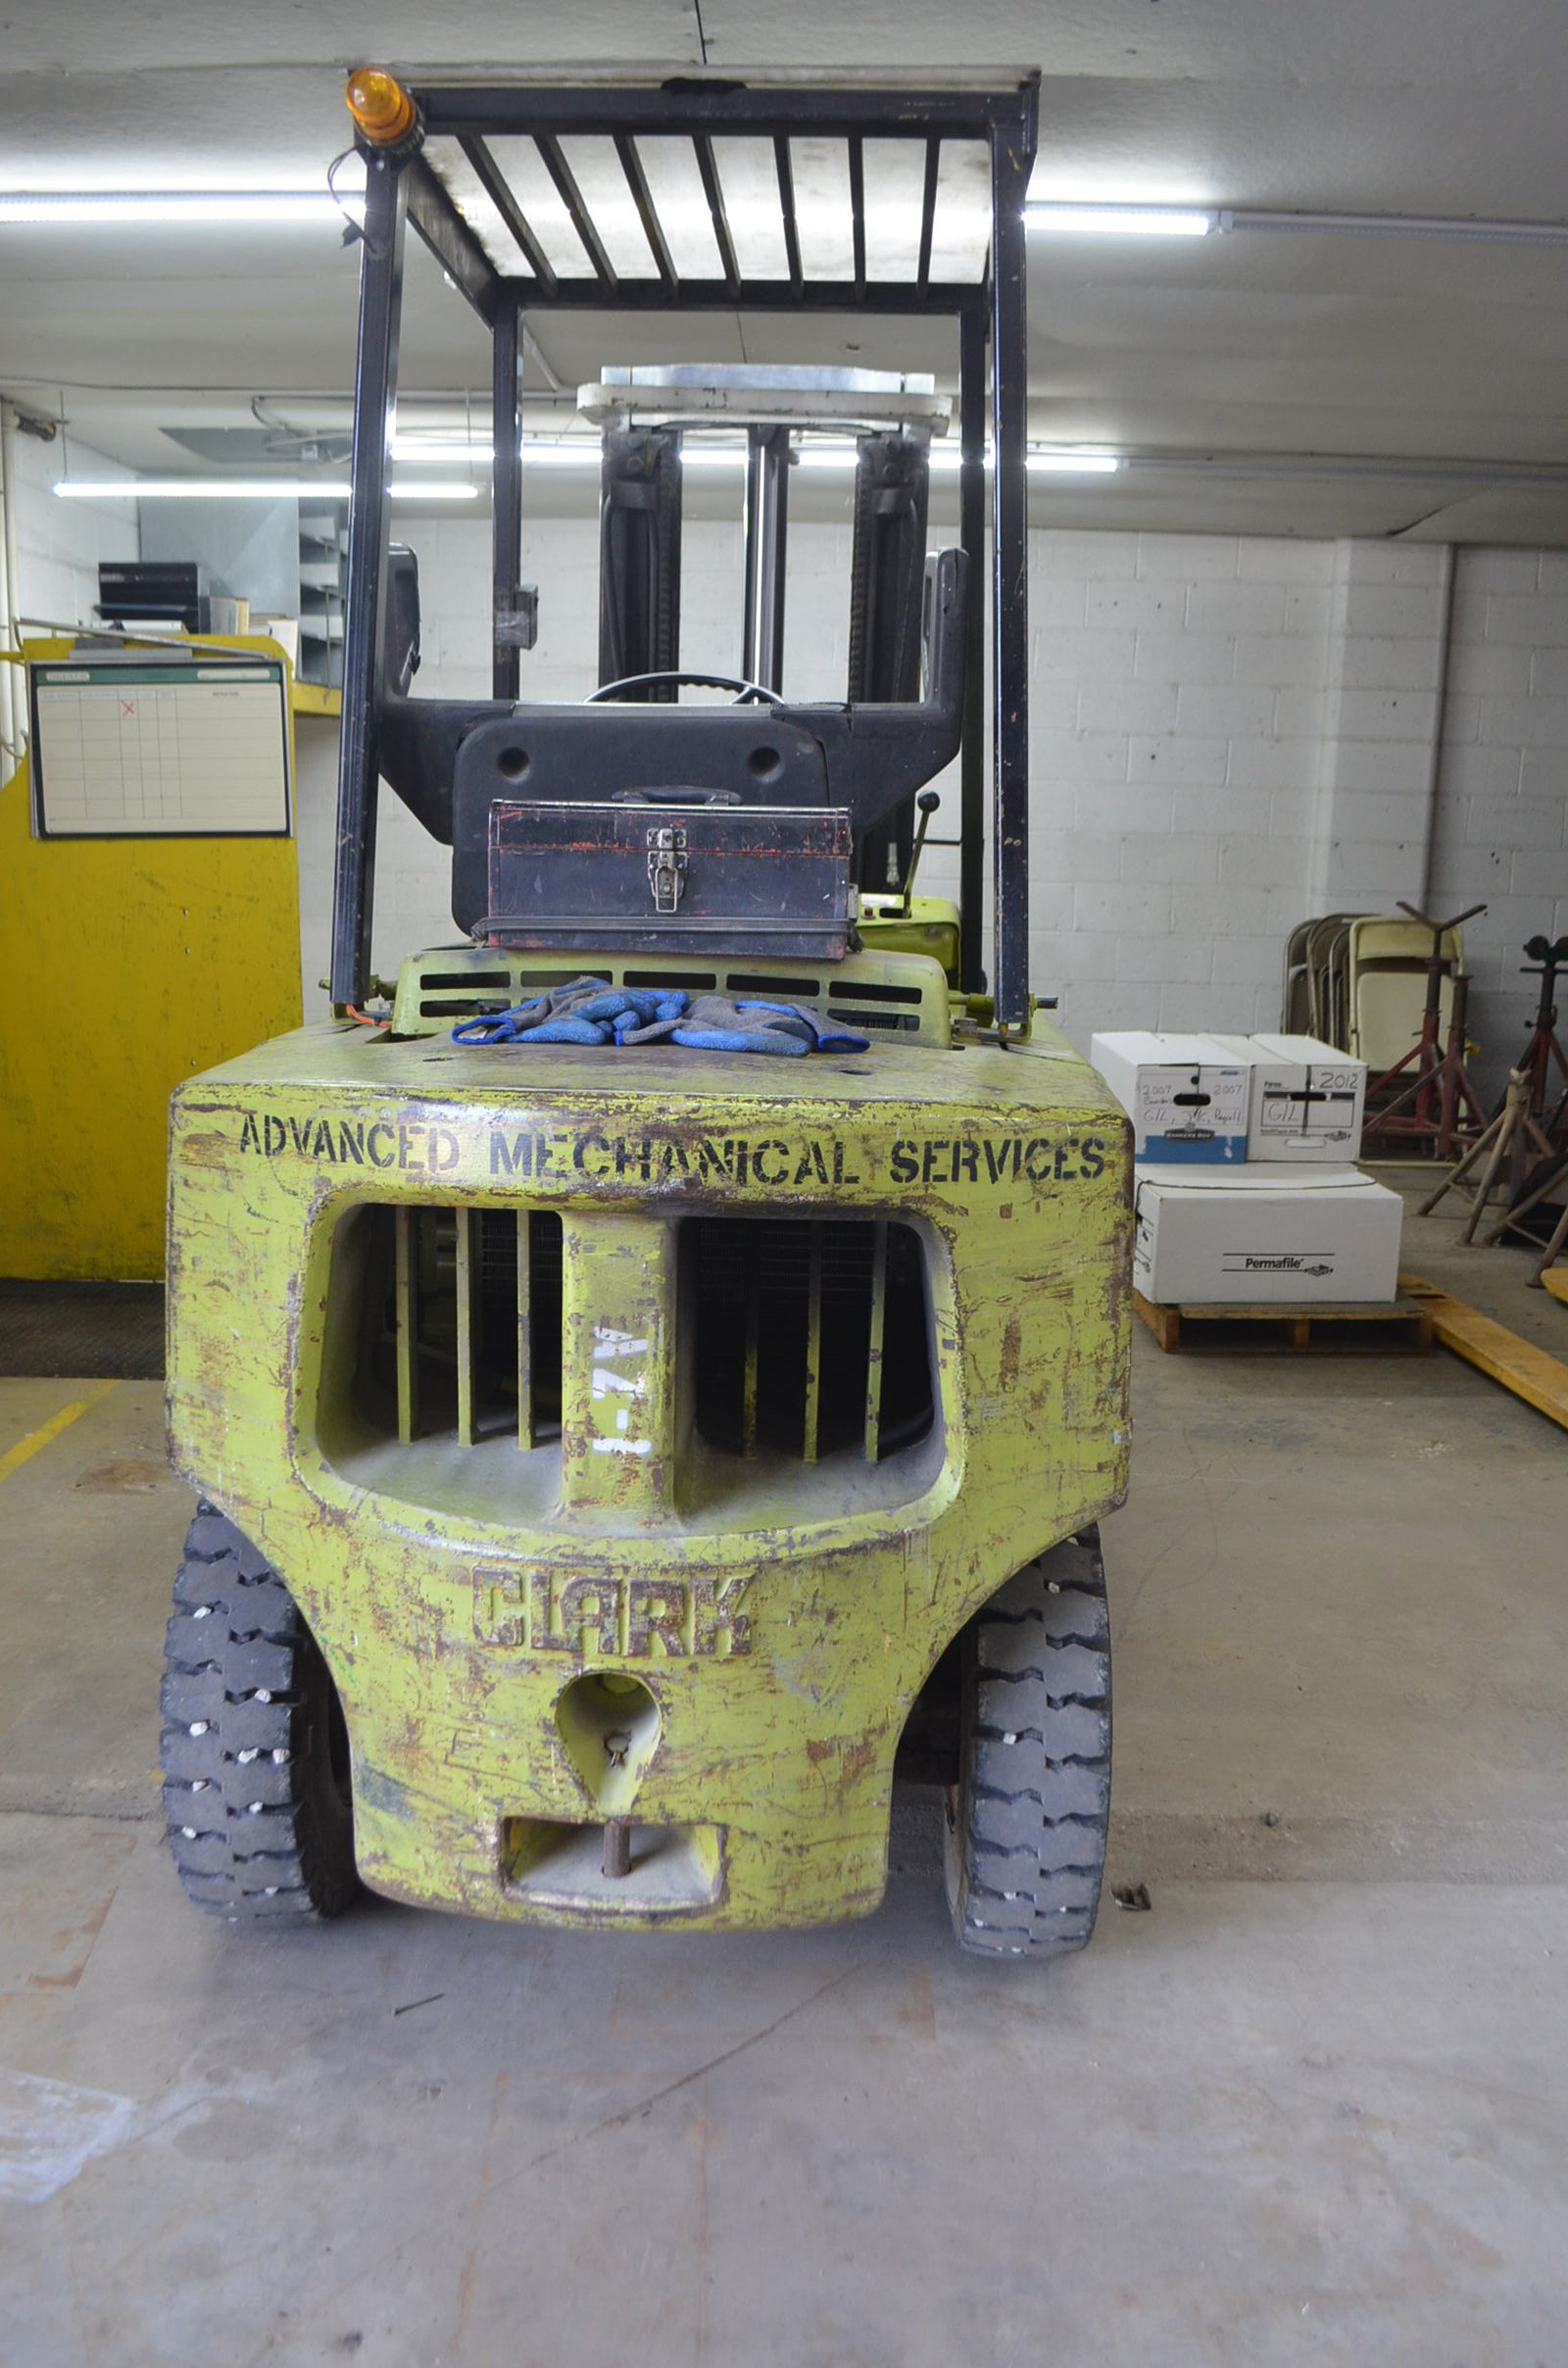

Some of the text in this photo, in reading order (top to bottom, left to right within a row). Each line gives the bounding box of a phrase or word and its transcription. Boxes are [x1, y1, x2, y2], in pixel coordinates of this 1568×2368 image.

[1142, 1083, 1244, 1096] 2007 2007
[1319, 1072, 1358, 1090] 2012
[240, 1113, 1105, 1185] ADVANCED MECHANICAL SERVICES
[1246, 1257, 1301, 1269] Permafile
[471, 1563, 755, 1657] CLARK
